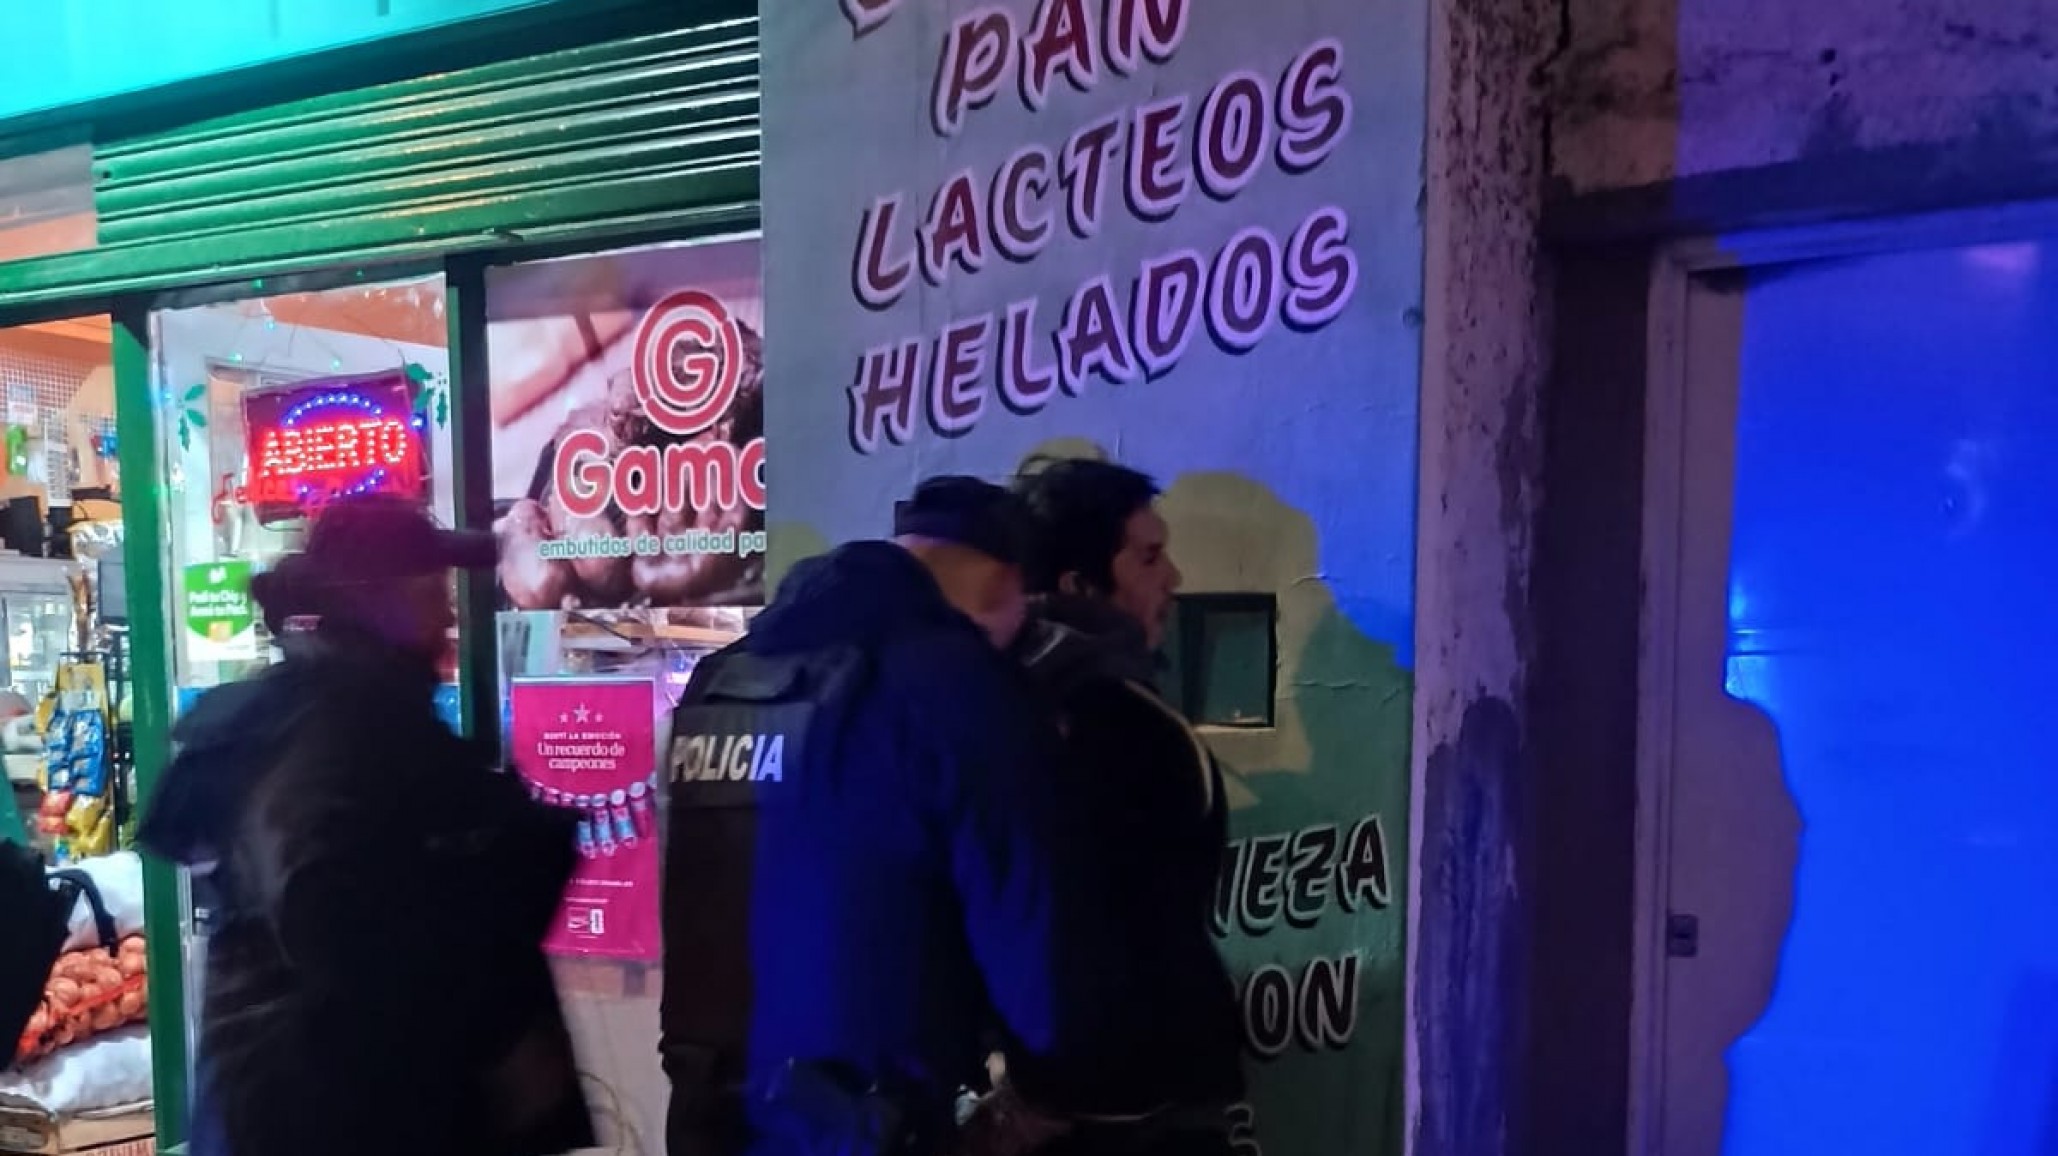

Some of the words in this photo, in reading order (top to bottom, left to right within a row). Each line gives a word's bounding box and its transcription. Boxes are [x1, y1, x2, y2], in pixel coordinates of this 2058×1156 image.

[932, 0, 1188, 135] PAN
[853, 38, 1354, 309] LACTEOS
[846, 206, 1358, 453] HELADOS
[262, 418, 406, 477] ABIERTO
[539, 533, 632, 559] embutidos
[634, 531, 661, 556] de
[664, 527, 736, 555] calidad
[537, 741, 553, 756] Un
[555, 741, 608, 756] recuerdo
[609, 741, 625, 757] de
[548, 757, 617, 772] campeones
[670, 733, 785, 782] POLICIA
[1236, 953, 1361, 1062] ON
